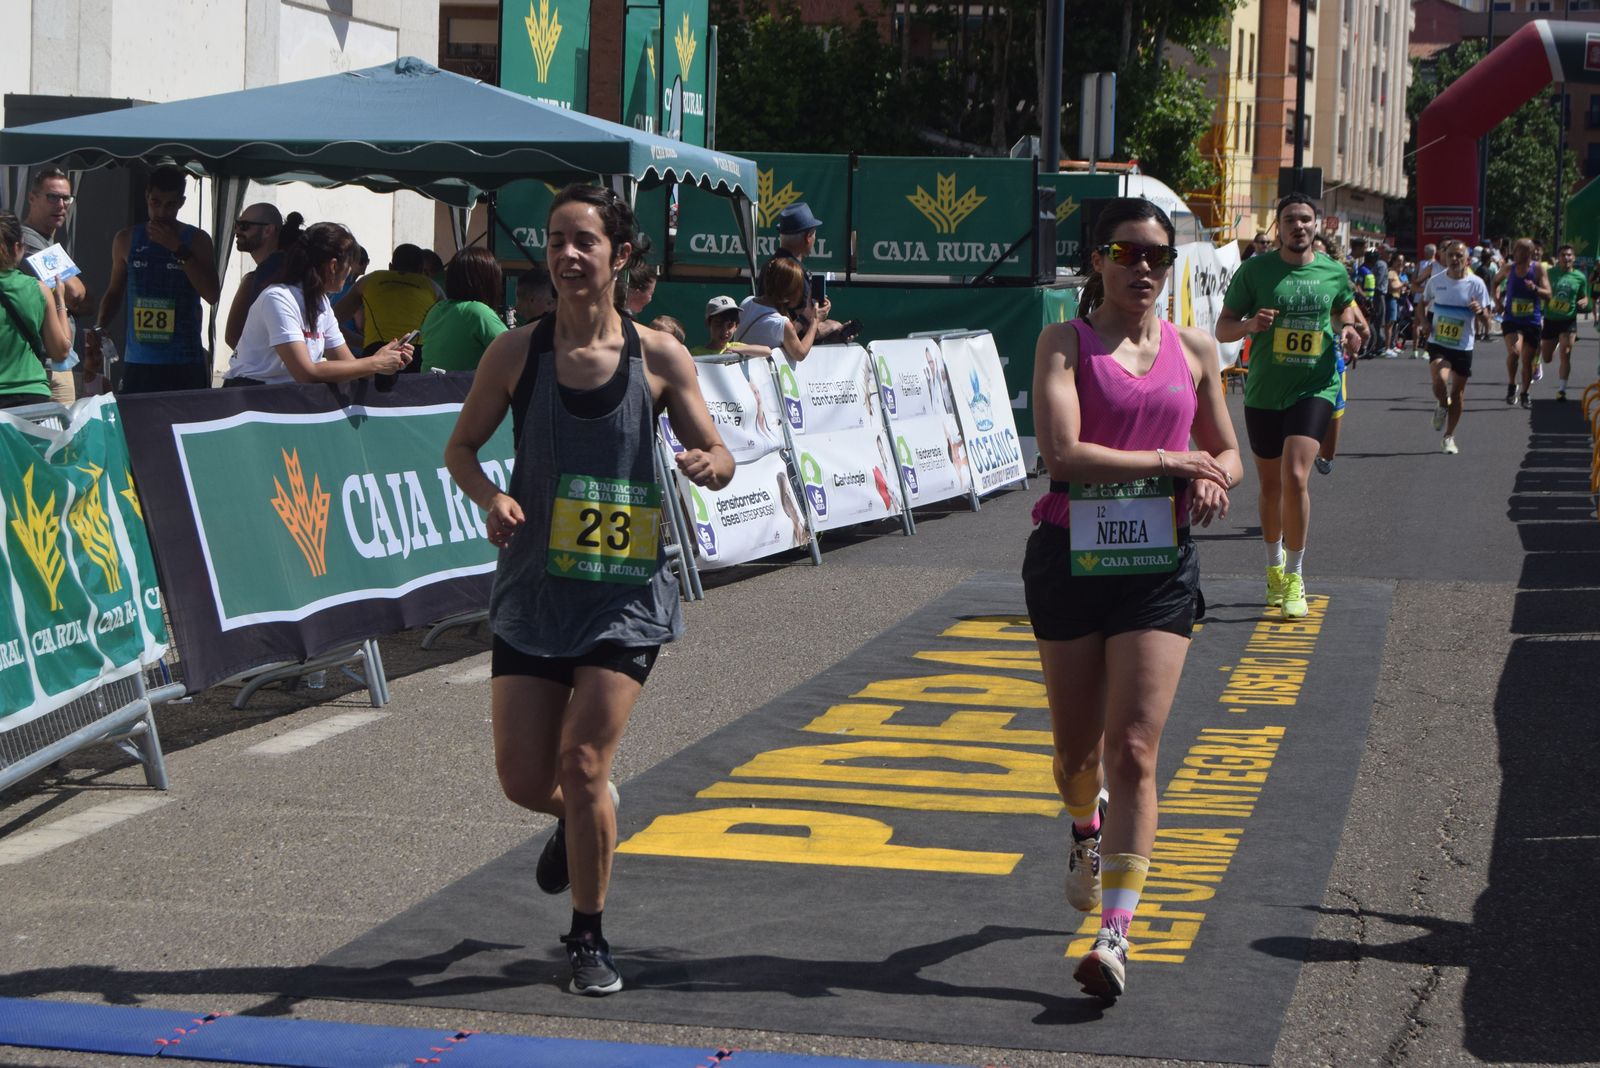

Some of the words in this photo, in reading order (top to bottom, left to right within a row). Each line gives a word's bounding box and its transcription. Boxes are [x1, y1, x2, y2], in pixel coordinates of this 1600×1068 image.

[1433, 221, 1471, 229] ZAMORA
[690, 233, 746, 255] CAJA
[872, 240, 930, 263] CAJA
[936, 241, 1019, 264] RURAL
[136, 309, 168, 330] 128
[1440, 323, 1459, 337] 149
[1286, 332, 1313, 353] 66
[968, 427, 1019, 475] OCEANIC
[587, 490, 612, 502] CAJA
[614, 493, 647, 506] RURAL
[1100, 488, 1125, 498] CAJA
[1127, 485, 1161, 496] RURAL
[341, 470, 443, 560] CAJA
[1096, 505, 1107, 519] 12
[576, 507, 631, 551] 23
[1096, 519, 1149, 545] NEREA
[577, 560, 606, 574] CAJA
[608, 563, 649, 578] RURAL
[1101, 557, 1130, 568] CAJA
[1132, 554, 1173, 566] RURAL
[1218, 656, 1311, 705] DISEÑO
[1157, 725, 1287, 818] INTEGRAL
